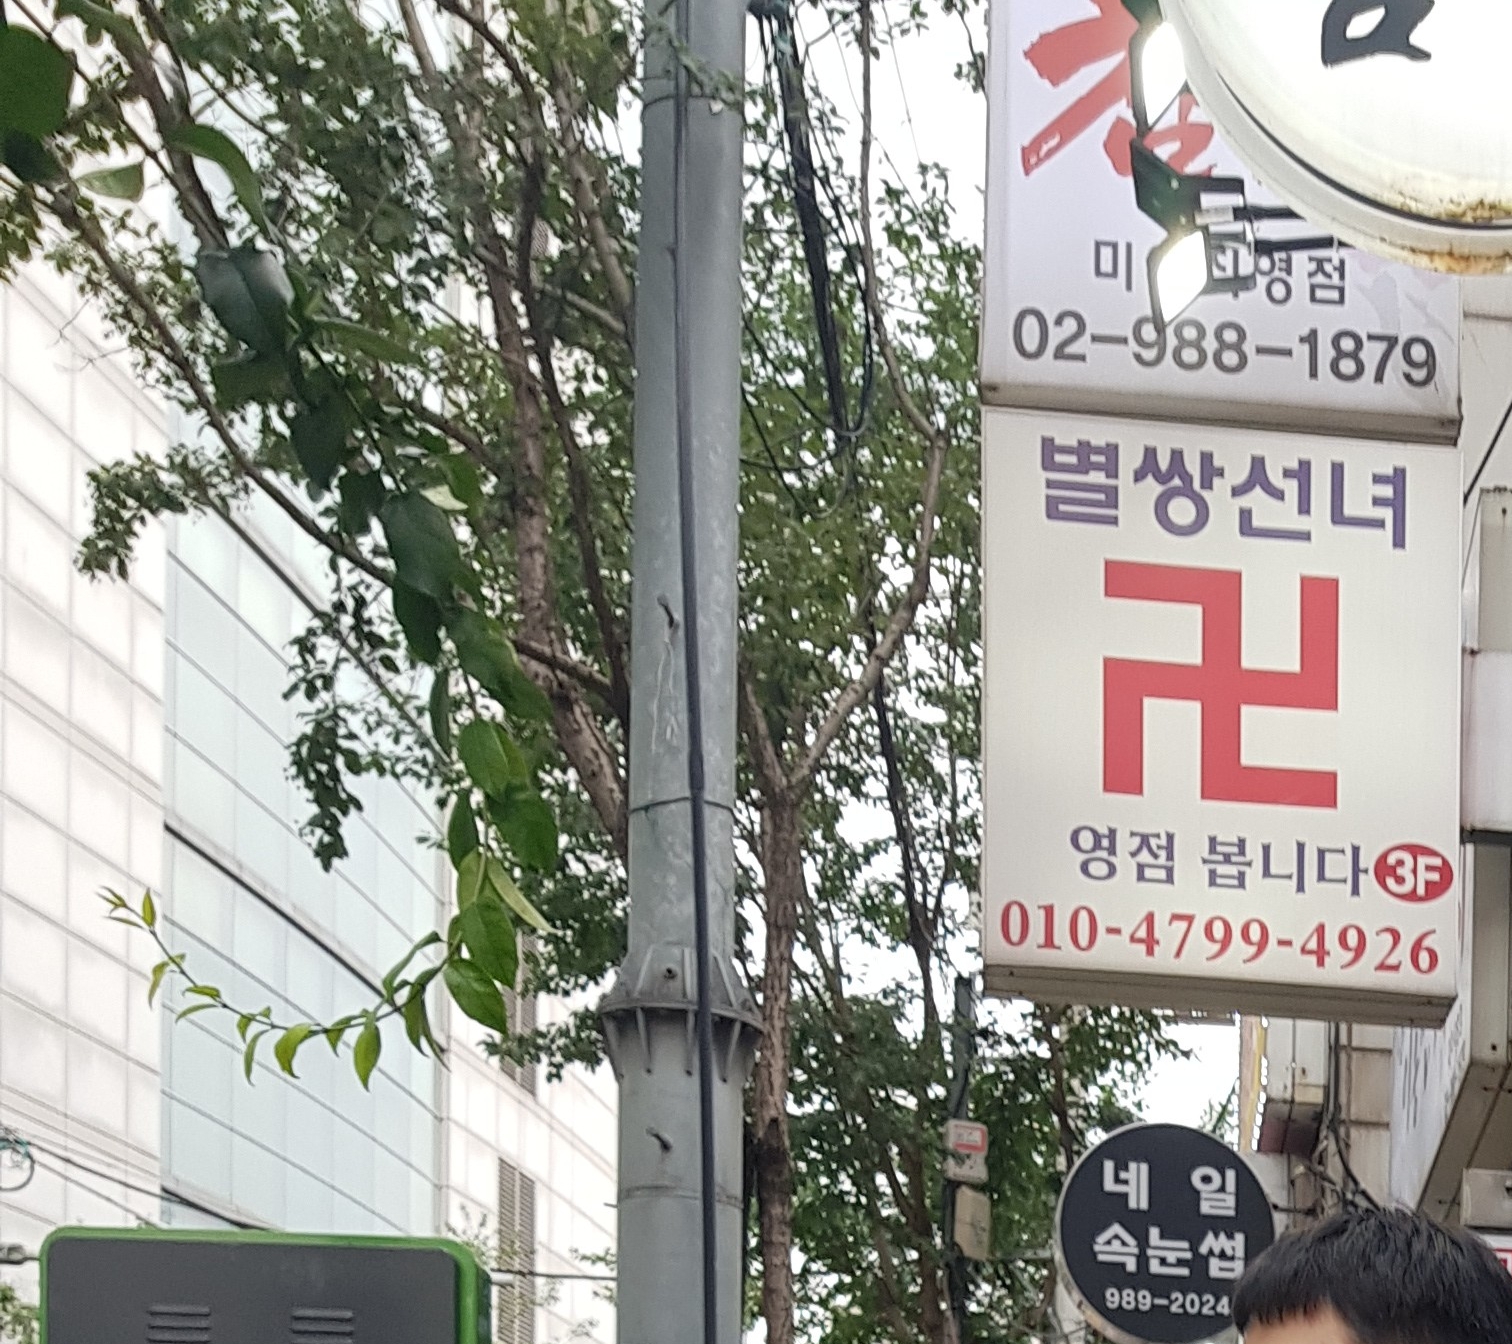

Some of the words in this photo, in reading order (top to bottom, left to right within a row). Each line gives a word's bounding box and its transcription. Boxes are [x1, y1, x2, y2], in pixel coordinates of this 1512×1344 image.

[1012, 307, 1437, 388] 02-988-1879
[1041, 435, 1406, 549] 별쌍선녀
[1070, 825, 1176, 887] 영점
[1200, 834, 1369, 898] 봅니다
[1001, 900, 1439, 975] 010-4799-4926
[1093, 1222, 1247, 1280] 속눈썹
[1105, 1289, 1230, 1316] 989-2024
